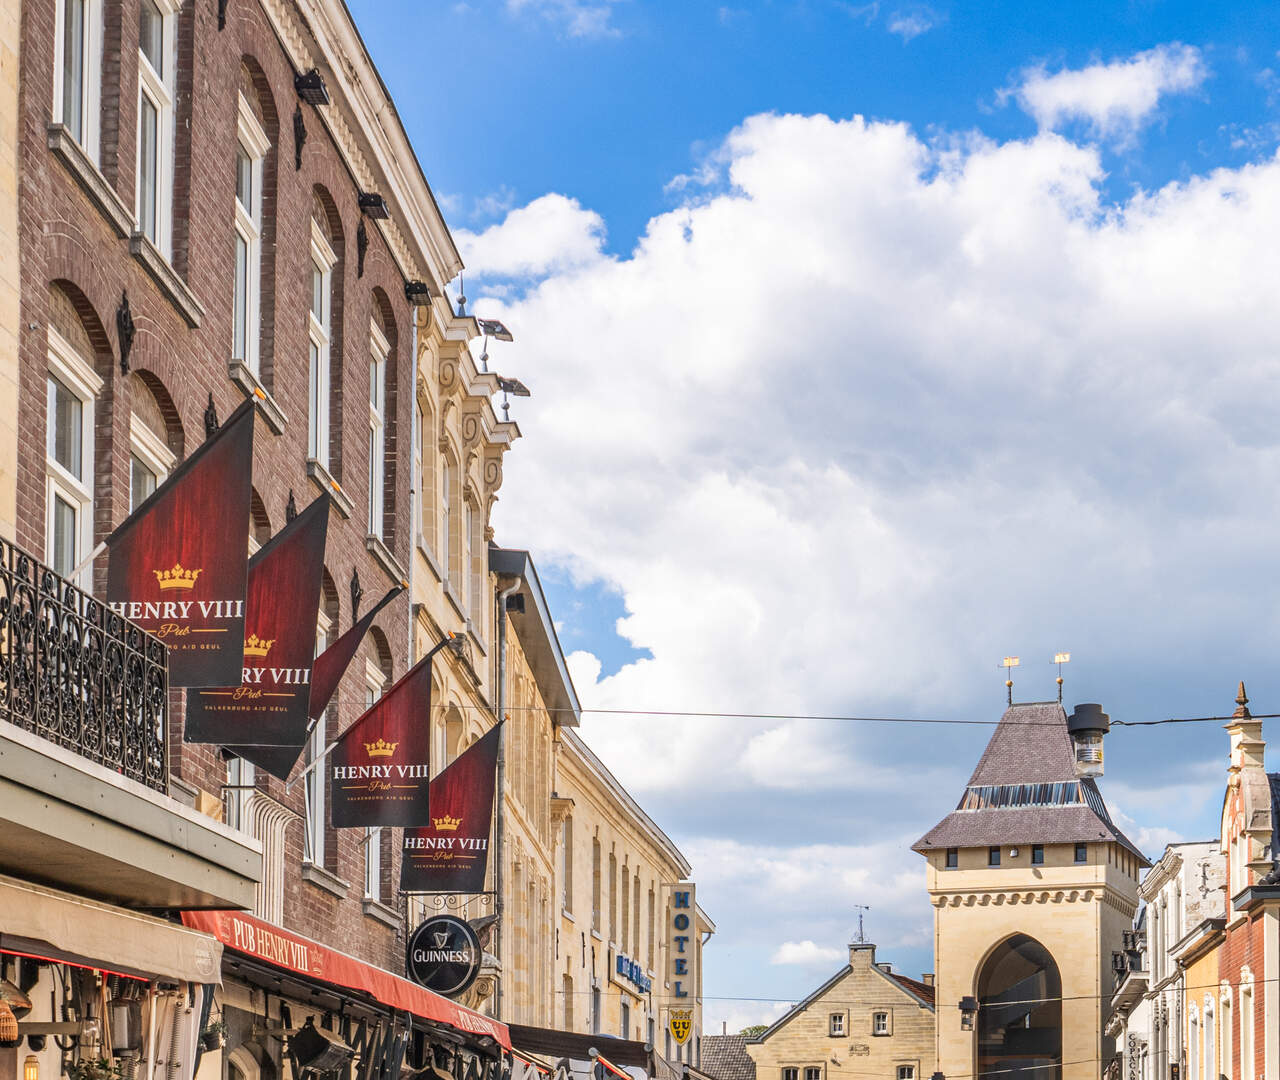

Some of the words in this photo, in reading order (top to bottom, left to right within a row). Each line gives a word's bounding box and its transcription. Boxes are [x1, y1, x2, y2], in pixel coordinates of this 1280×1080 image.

[109, 600, 194, 619] HENRY
[198, 600, 243, 619] VIII
[157, 624, 191, 638] Pub
[270, 667, 311, 685] VIII
[233, 687, 262, 700] Pub
[333, 765, 394, 780] HENRY
[396, 764, 429, 779] VIII
[405, 837, 458, 850] HENRY
[458, 838, 488, 851] VIII
[233, 918, 256, 952] PUB
[256, 928, 290, 966] HENRY
[290, 941, 309, 972] VIII
[675, 891, 690, 998] HOTEL
[414, 948, 469, 963] GUINNESS
